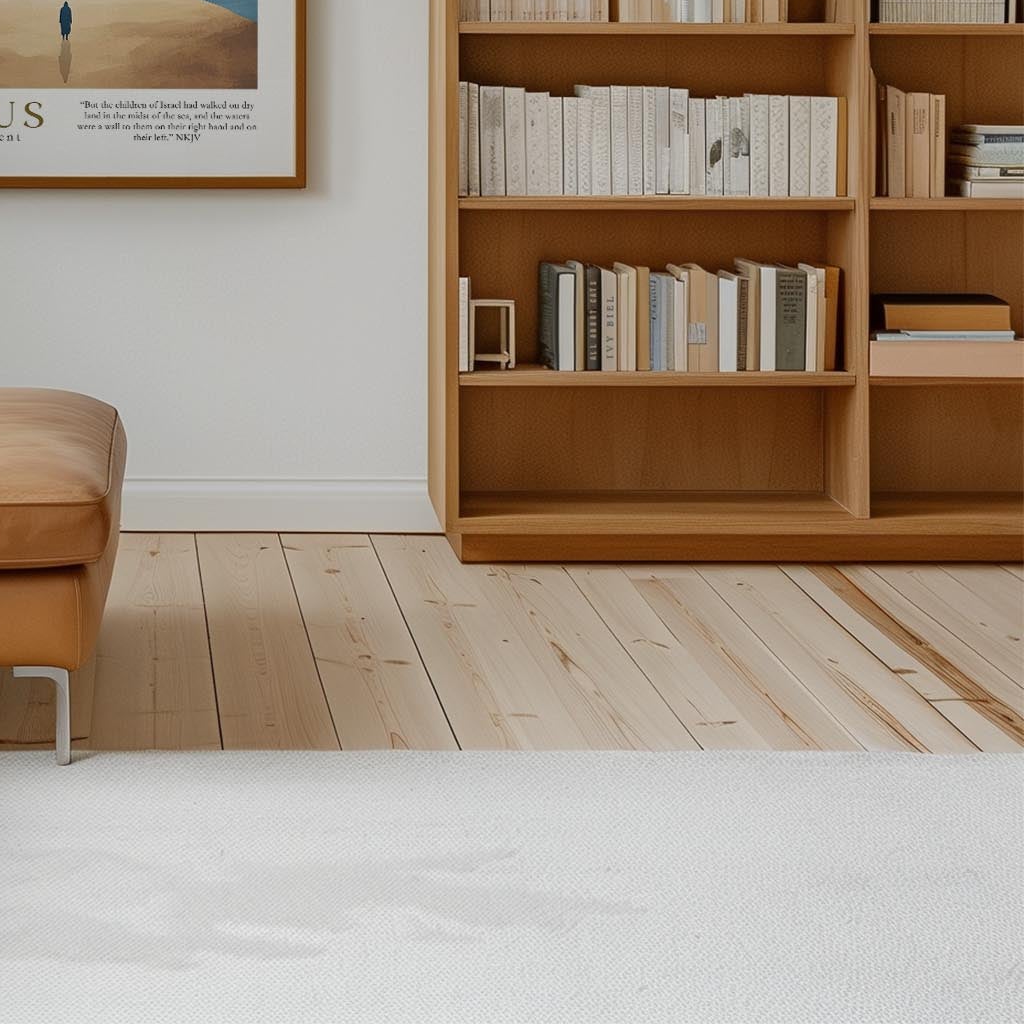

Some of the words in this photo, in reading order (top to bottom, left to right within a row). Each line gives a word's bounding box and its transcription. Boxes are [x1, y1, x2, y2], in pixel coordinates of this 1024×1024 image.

[101, 101, 113, 109] the
[115, 101, 147, 109] children
[149, 101, 160, 109] of
[160, 101, 181, 109] Israel
[183, 101, 198, 109] had
[200, 101, 227, 109] walked
[241, 101, 254, 111] dry
[188, 123, 206, 132] right
[176, 133, 201, 143] NKJV
[589, 281, 597, 303] CATS
[606, 295, 615, 327] BIEL
[589, 309, 597, 338] ABOUT
[589, 343, 597, 361] ALL
[605, 335, 615, 360] IVY
